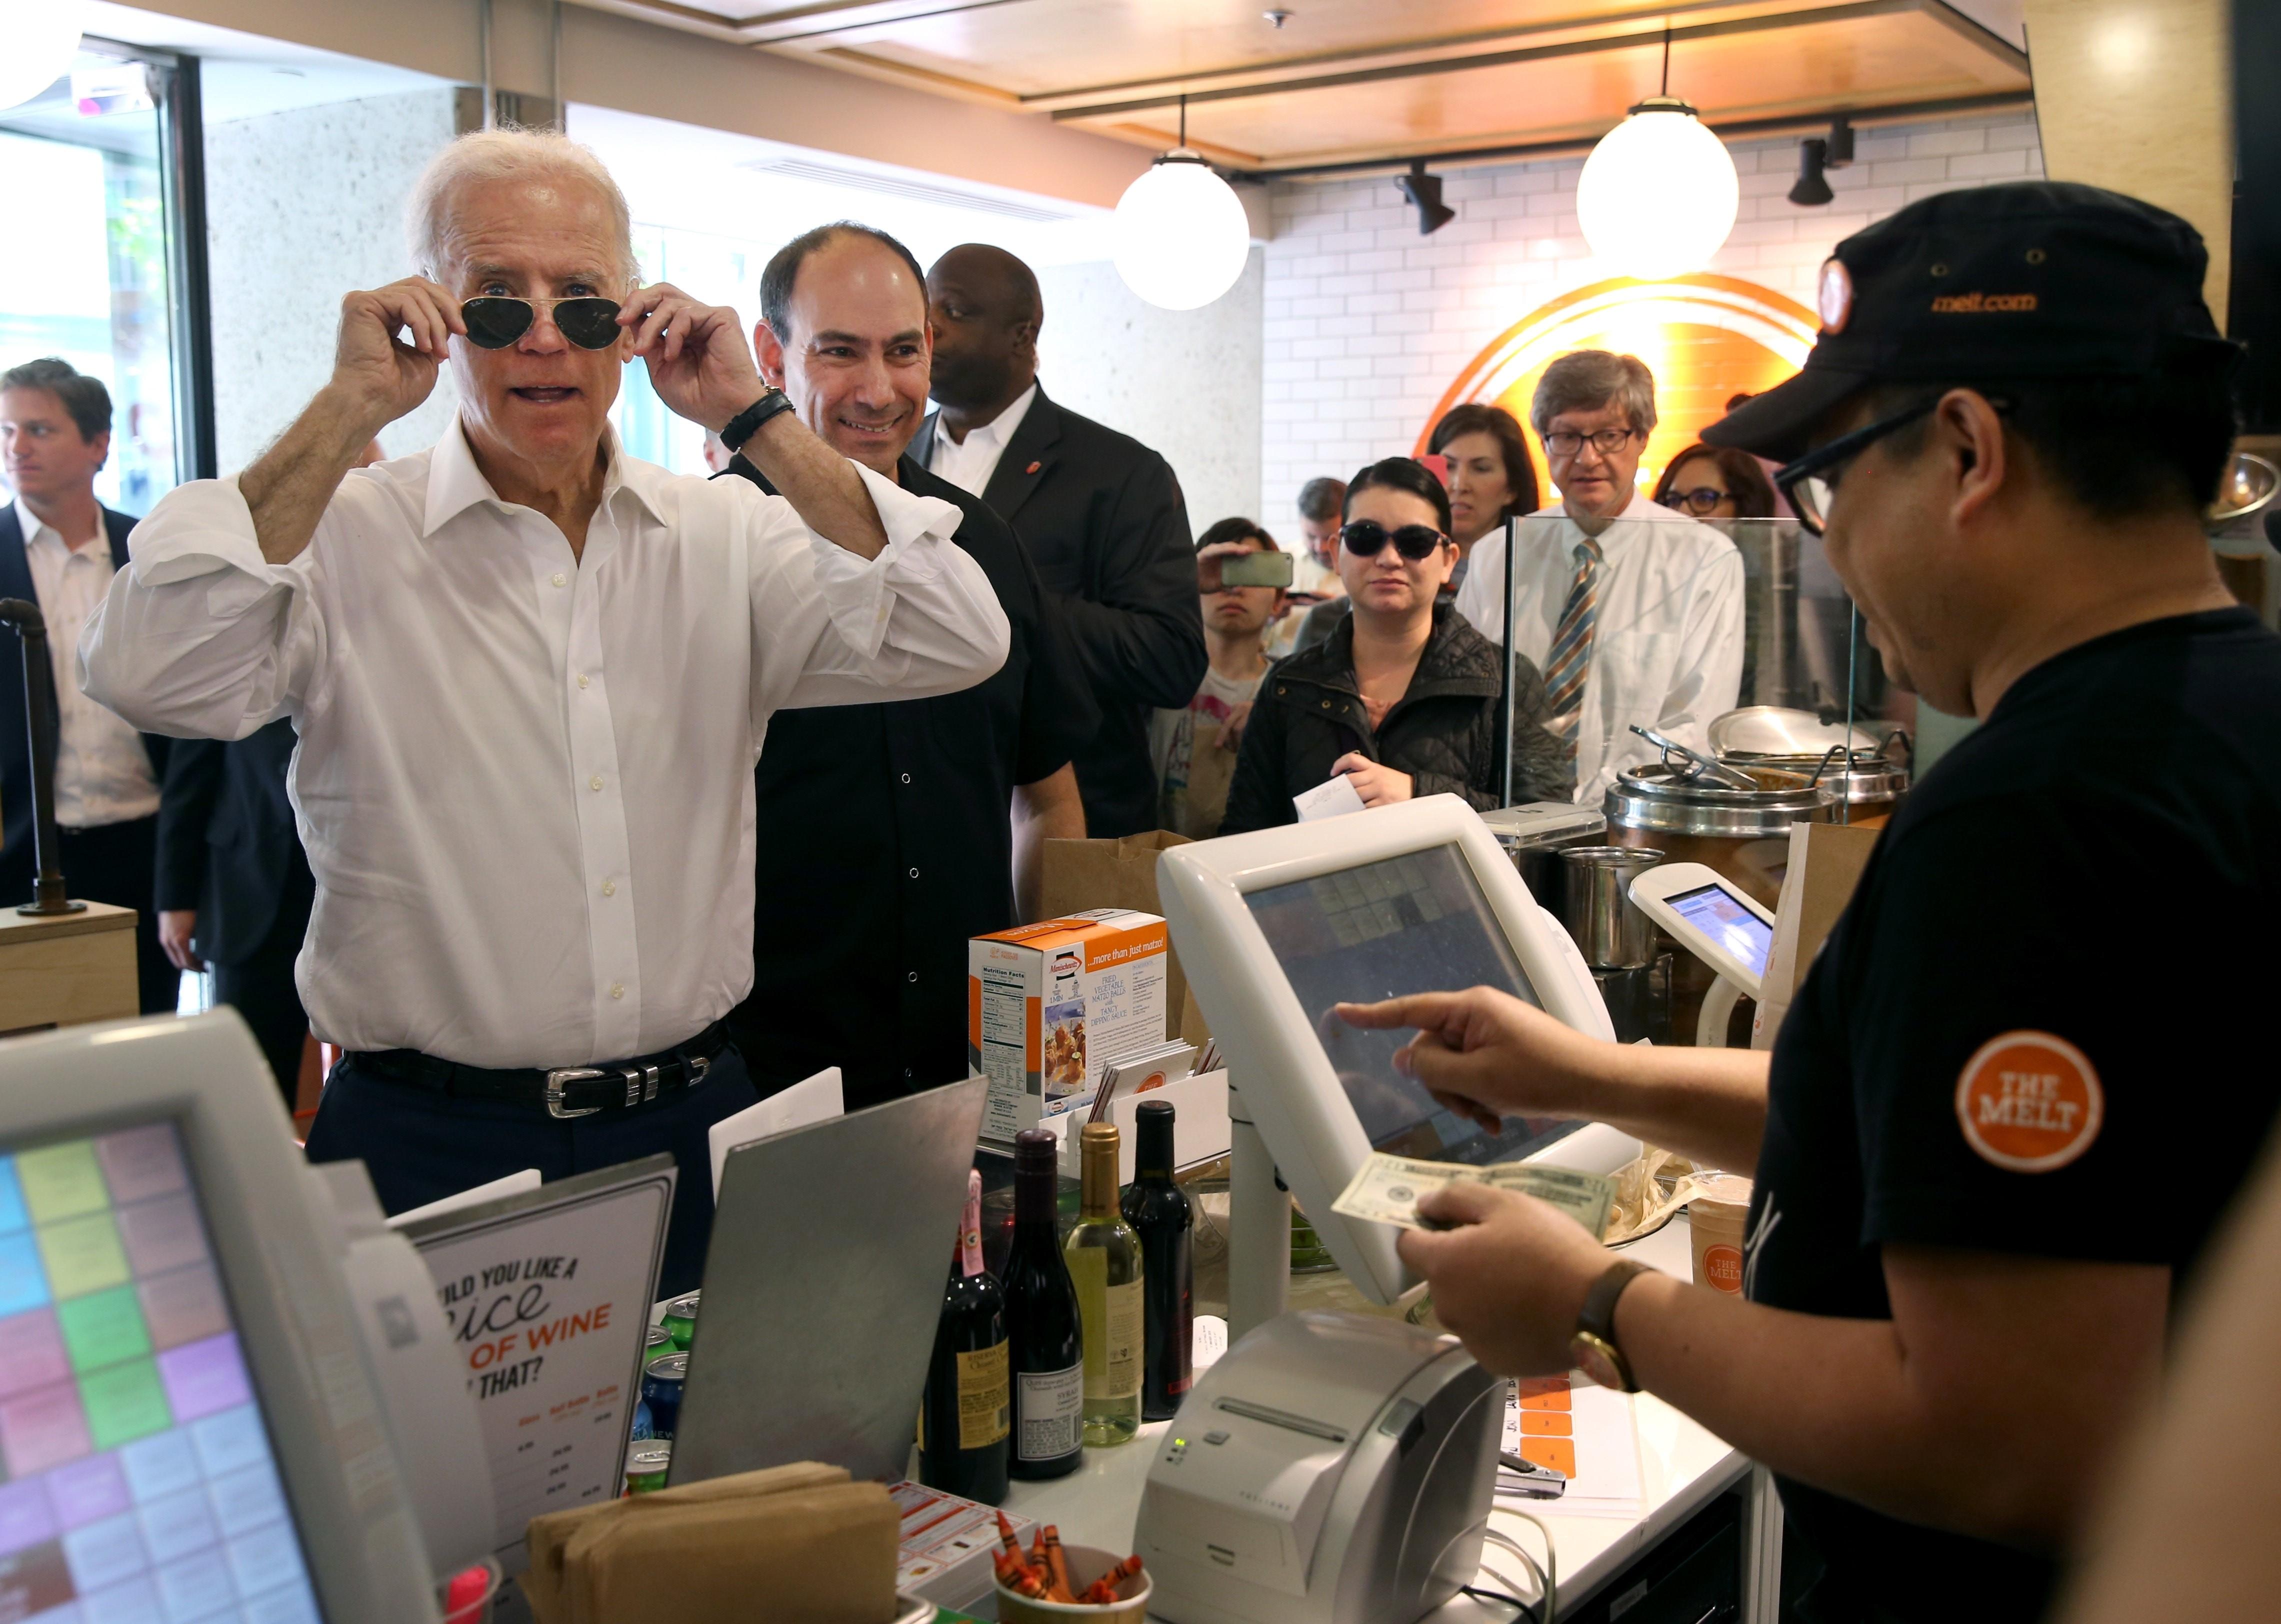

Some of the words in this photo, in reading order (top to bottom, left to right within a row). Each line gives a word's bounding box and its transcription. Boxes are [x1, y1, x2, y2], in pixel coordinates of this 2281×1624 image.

[1931, 292, 2037, 312] melt.com
[1112, 948, 1128, 960] than
[1129, 944, 1142, 958] just
[1143, 937, 1164, 952] matzo!
[984, 968, 1007, 976] Nutrition
[1102, 974, 1116, 984] FRIED
[1092, 992, 1110, 1002] MATZO
[1110, 987, 1126, 998] BALLS
[1094, 980, 1124, 994] VEGETABLE
[1091, 1014, 1110, 1026] DIPPING
[1111, 1009, 1127, 1020] SAUCE
[1100, 1004, 1118, 1016] TANGY
[1999, 1070, 2061, 1100] THE
[1978, 1094, 2080, 1133] MELT
[482, 1260, 520, 1289] YOU
[524, 1256, 564, 1280] LIKE
[562, 1258, 578, 1279] A
[1716, 1260, 1736, 1269] THE
[446, 1284, 550, 1344] ice
[470, 1334, 518, 1370] OF
[527, 1302, 612, 1351] WINE
[480, 1356, 543, 1400] THAT?
[1056, 1388, 1078, 1400] SYRAH
